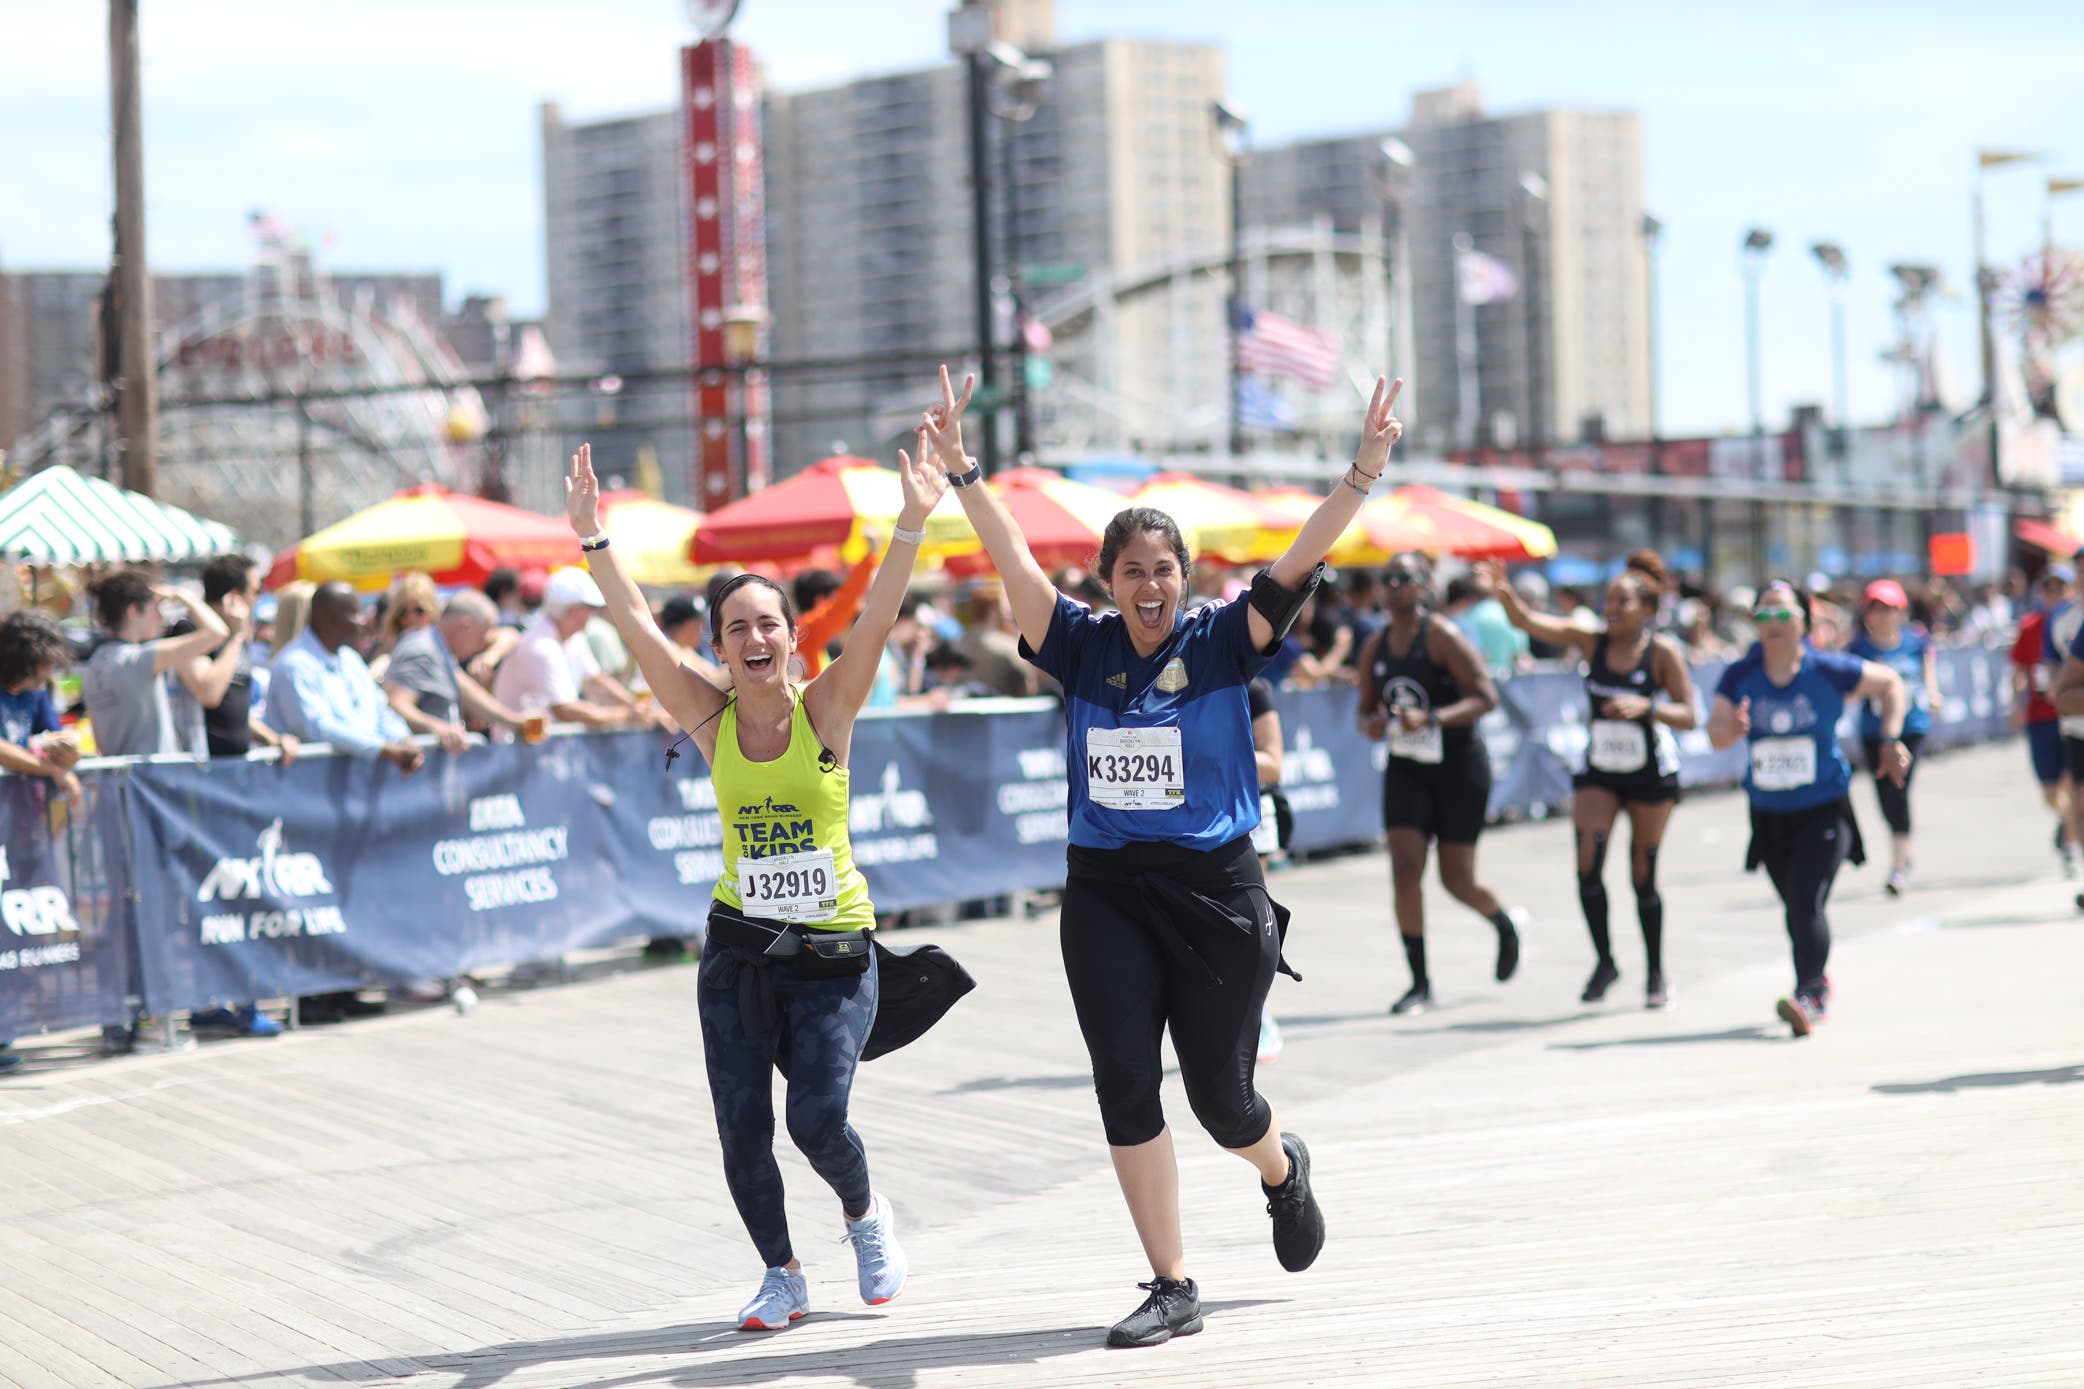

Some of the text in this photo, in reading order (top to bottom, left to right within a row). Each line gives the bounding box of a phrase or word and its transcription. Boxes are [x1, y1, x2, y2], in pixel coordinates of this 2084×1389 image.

[1089, 754, 1175, 783] K33294
[1140, 789, 1145, 797] 2
[733, 819, 814, 843] TEAM
[432, 825, 569, 876] CONSULTANCY
[464, 866, 559, 911] SERVICES
[745, 867, 827, 900] J32919
[0, 885, 81, 936] RR
[248, 907, 302, 941] FOR
[777, 904, 799, 913] WAVE 2
